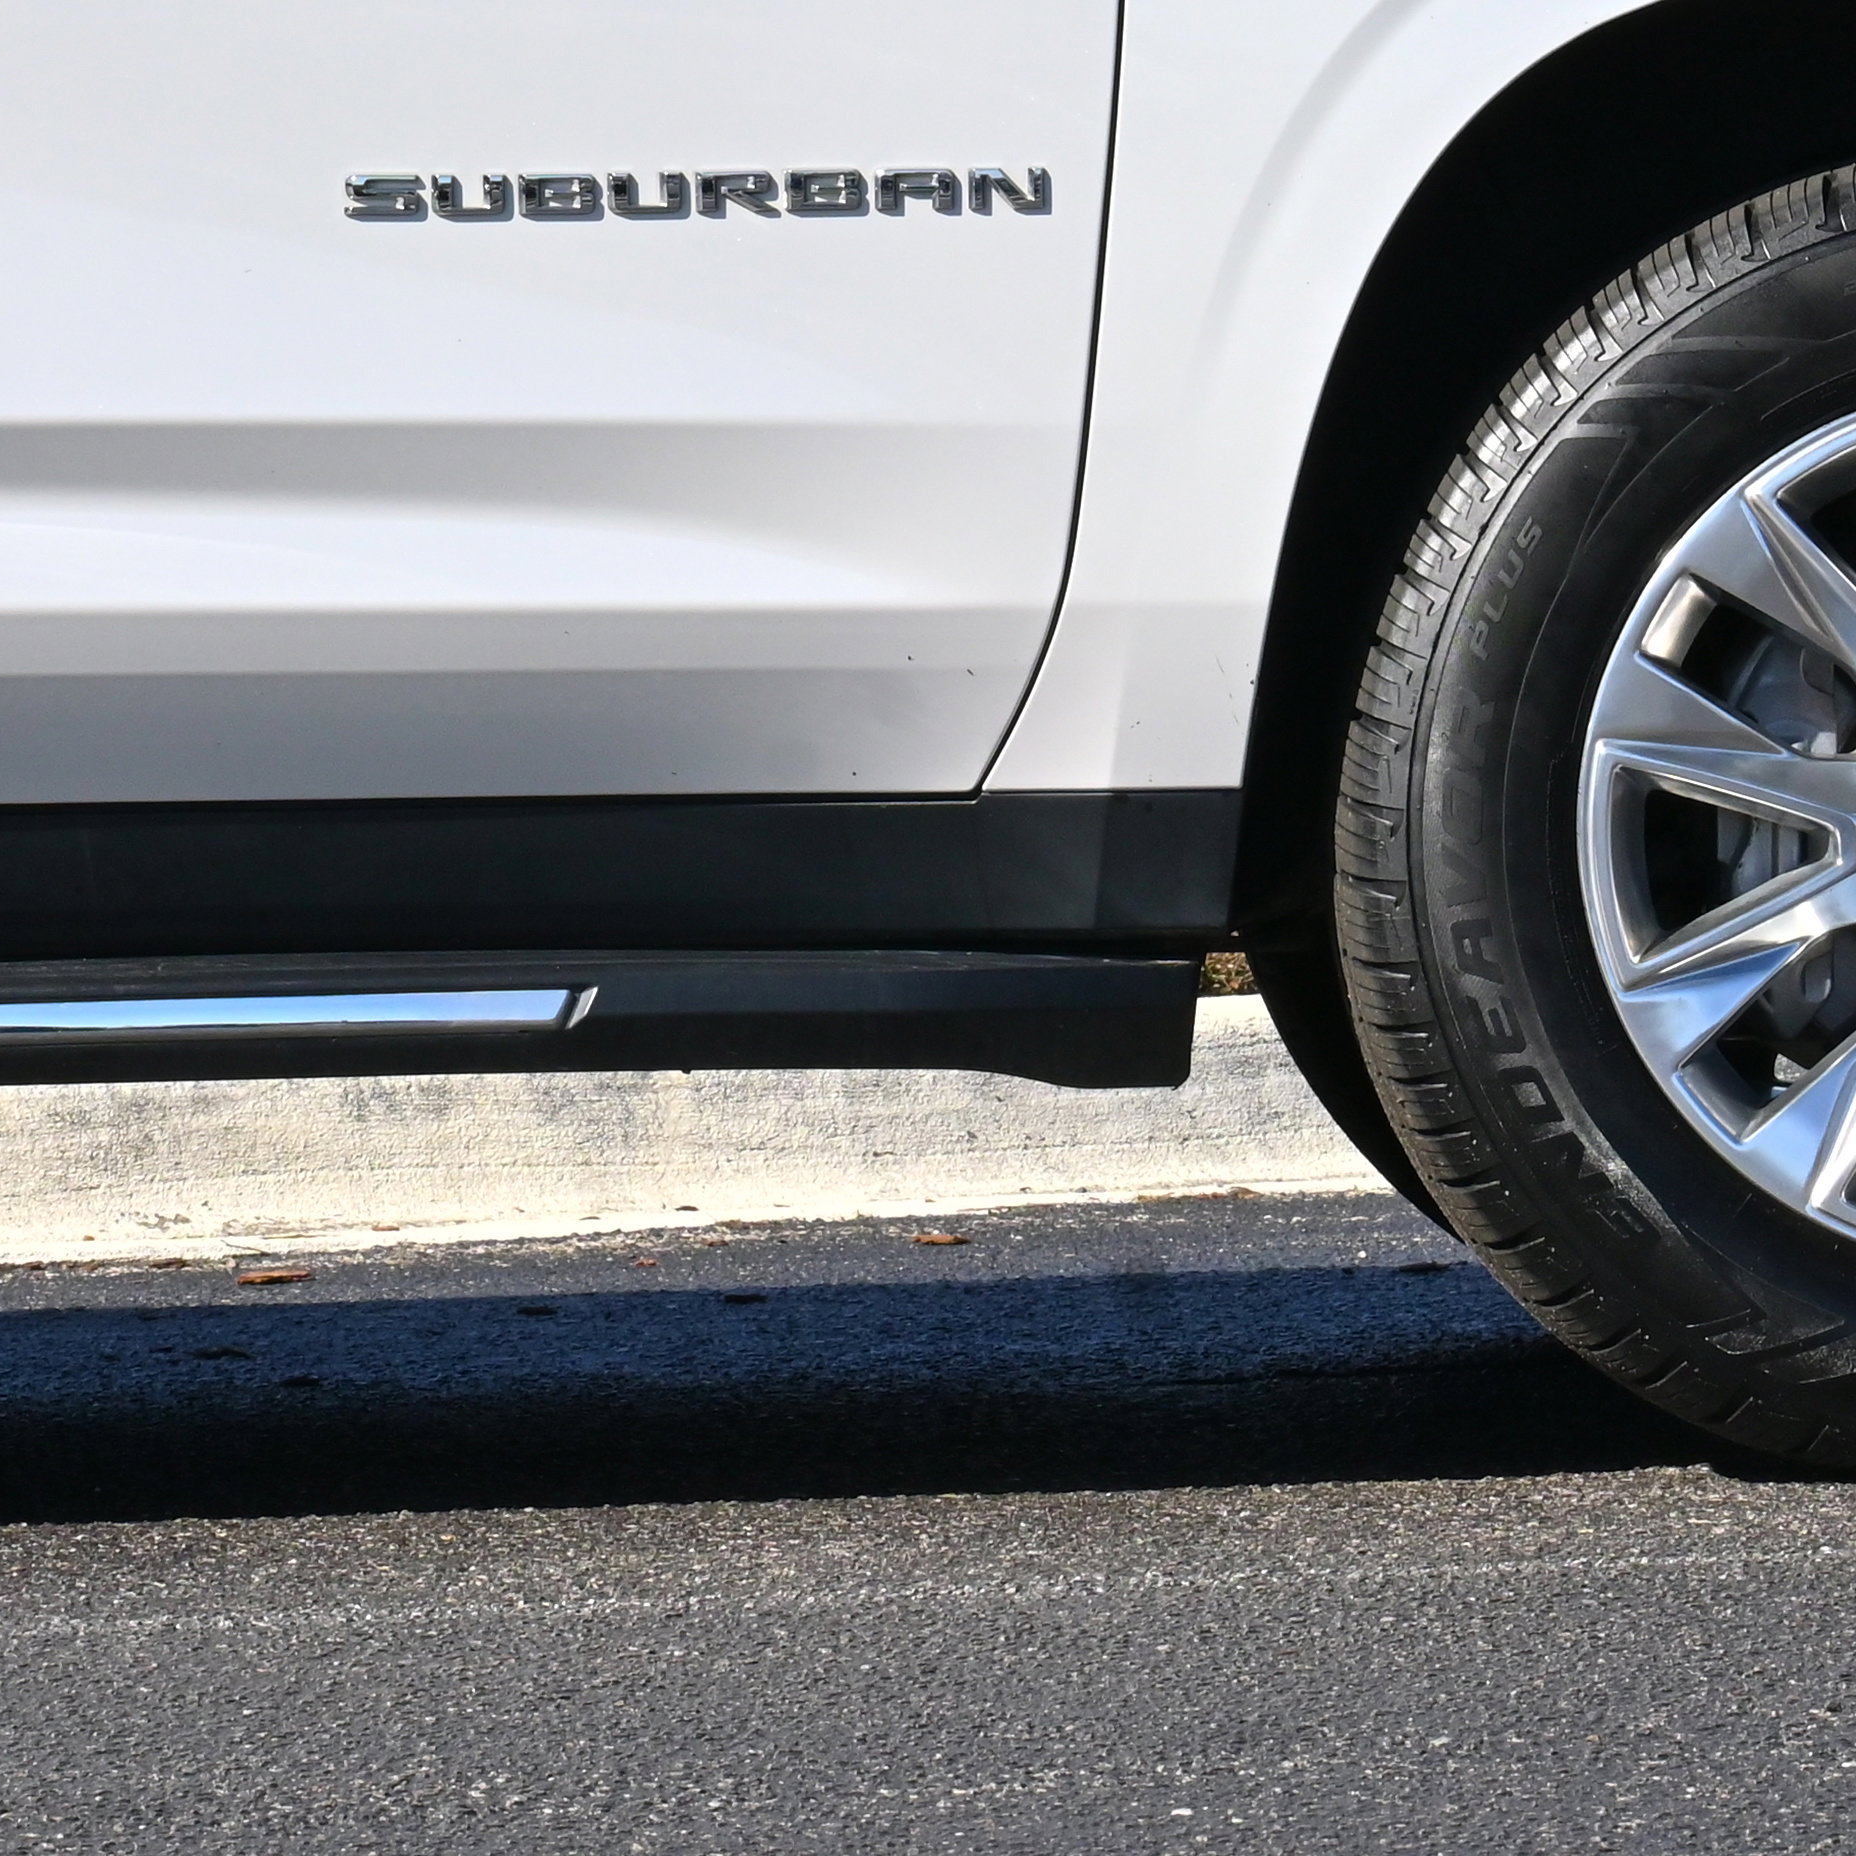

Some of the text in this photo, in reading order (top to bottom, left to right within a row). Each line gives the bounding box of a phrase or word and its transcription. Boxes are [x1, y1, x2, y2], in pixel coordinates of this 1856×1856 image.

[343, 167, 1050, 219] SUBURBAN
[1437, 516, 1661, 1252] ENDEAVOR PLUS
